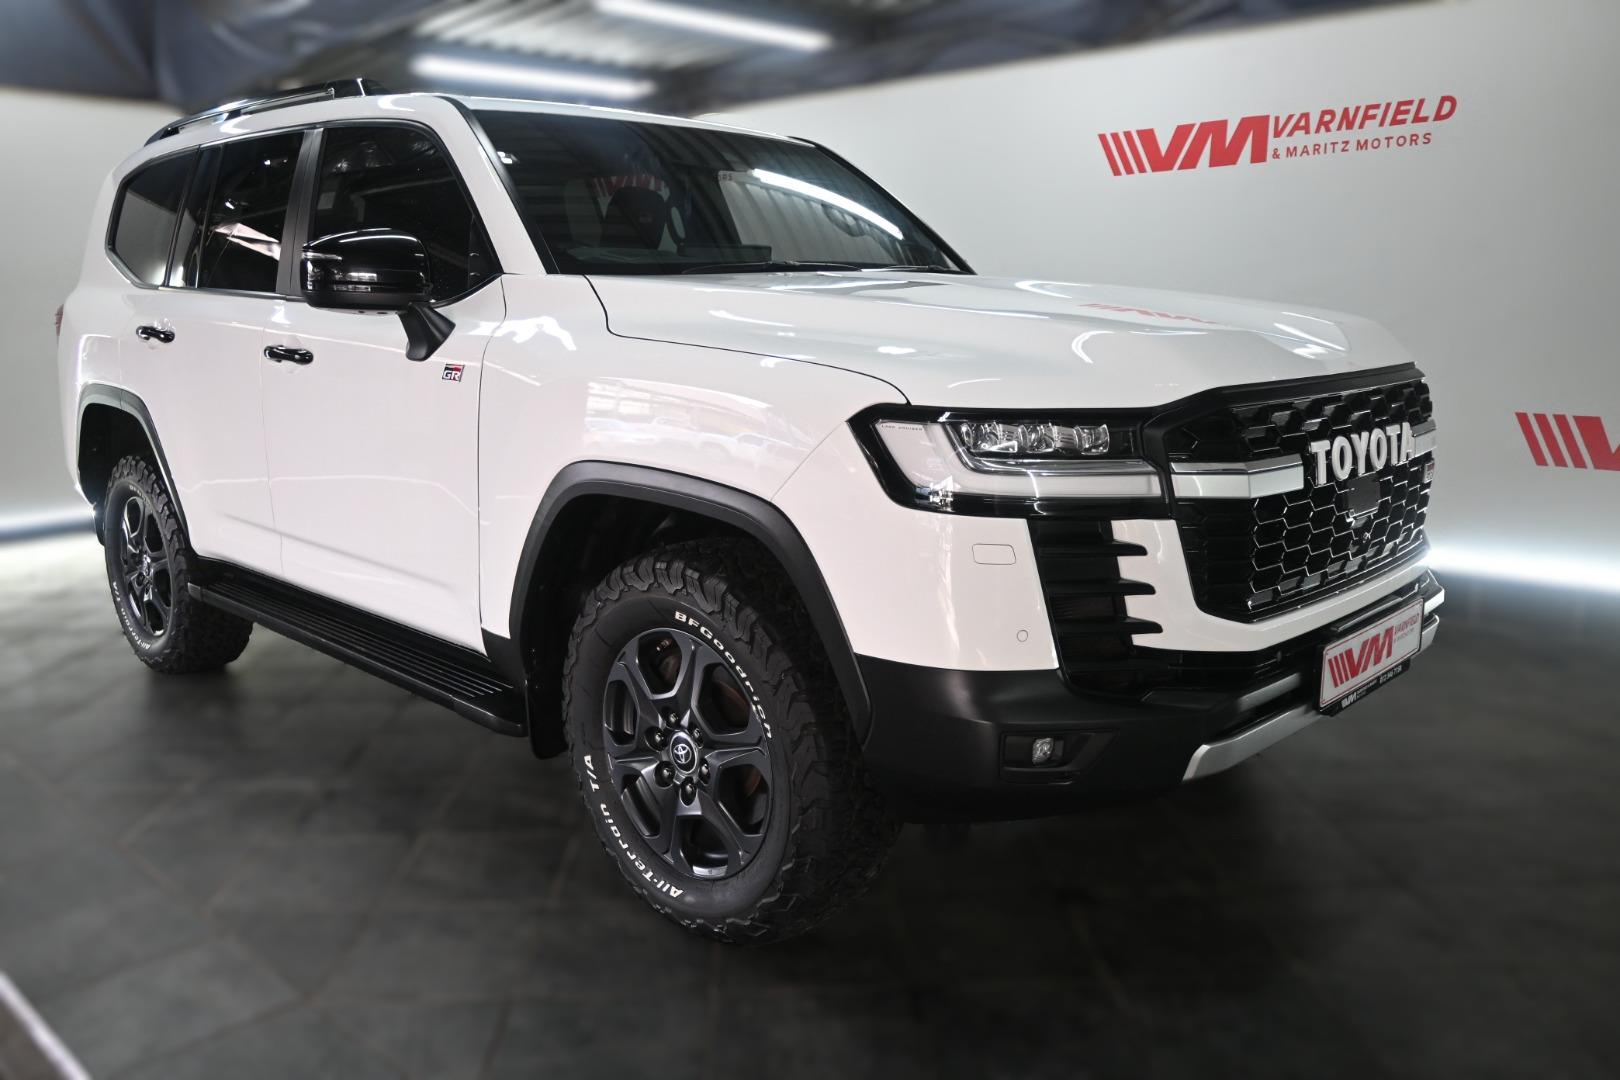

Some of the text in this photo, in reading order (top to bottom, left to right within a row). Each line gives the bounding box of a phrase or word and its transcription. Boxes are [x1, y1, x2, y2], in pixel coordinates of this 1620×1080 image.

[1136, 114, 1270, 172] VM
[1272, 95, 1458, 138] VARNFIELD
[1272, 132, 1433, 160] & MARITZ MOTORS
[442, 369, 461, 382] GR
[1309, 421, 1415, 487] TOYOTA
[674, 609, 773, 740] BFGoodrich
[1344, 626, 1394, 679] VM
[583, 754, 684, 899] All-Terrain T/A
